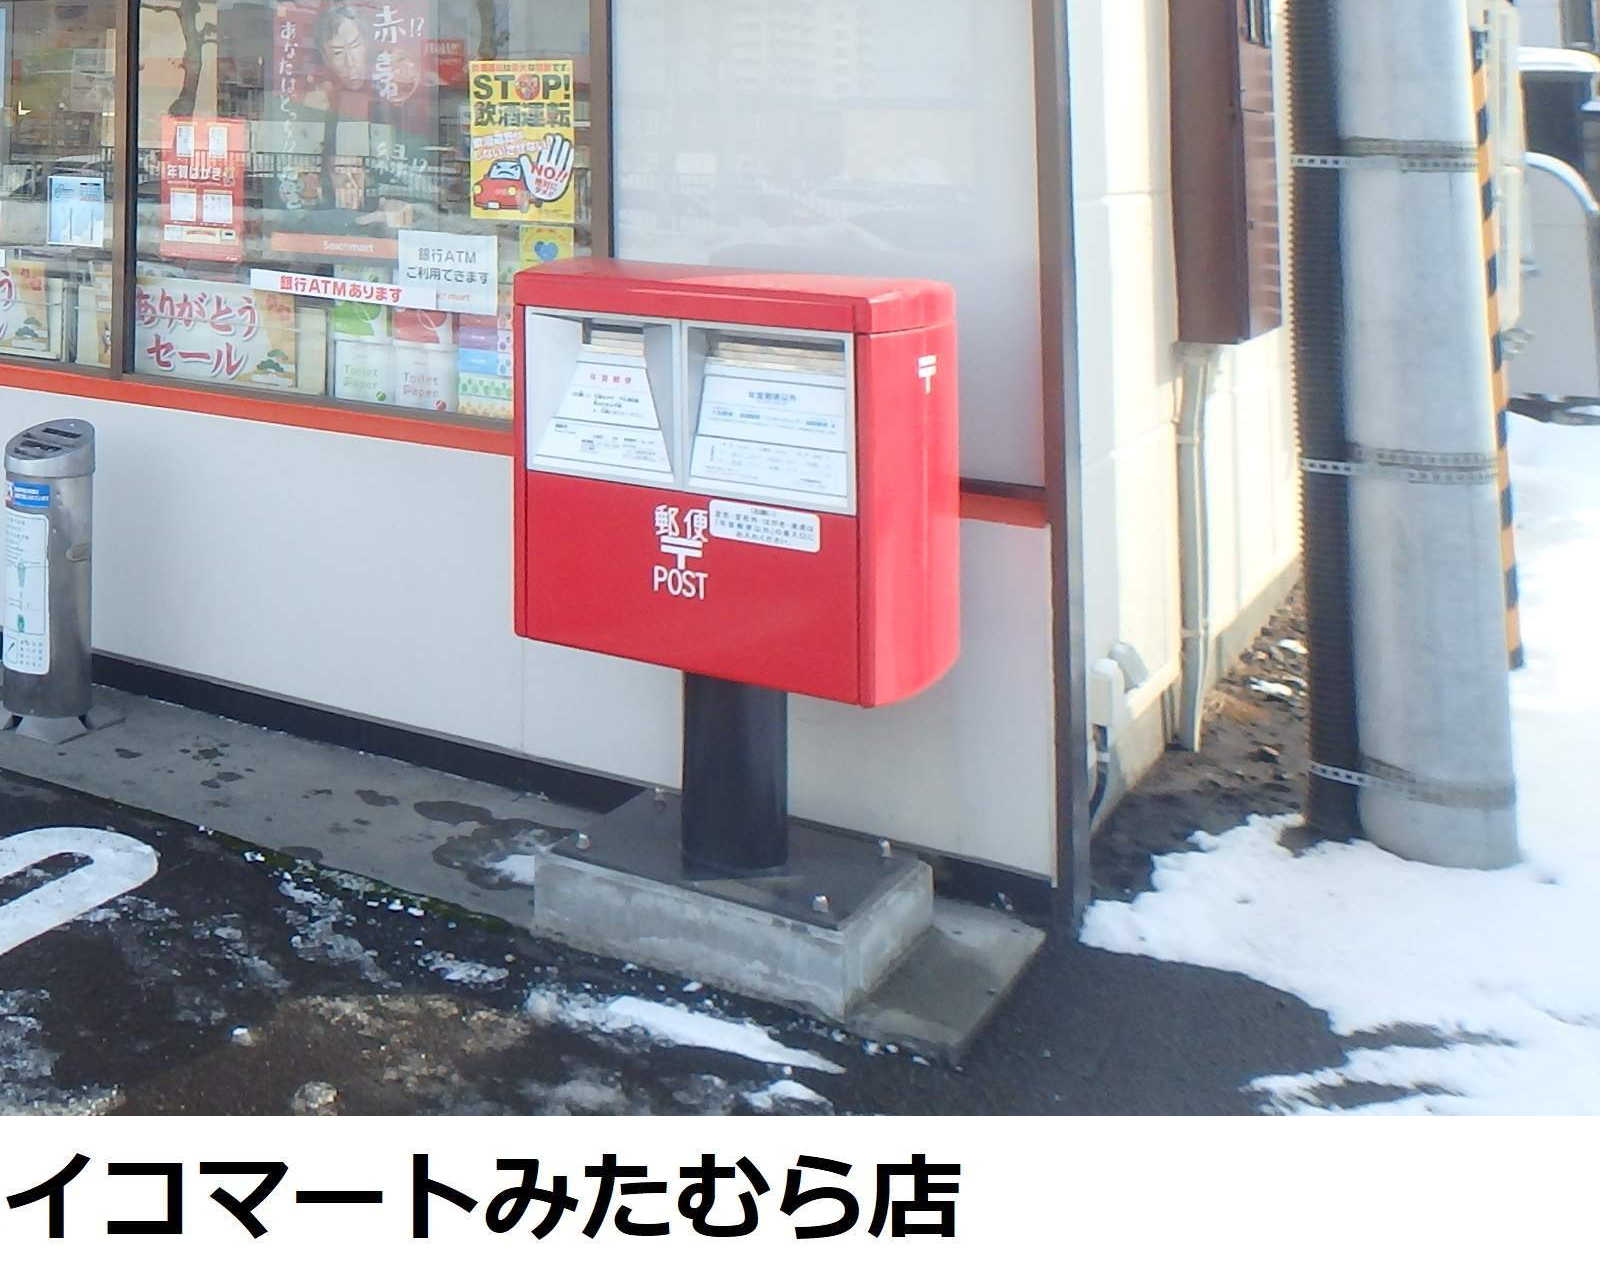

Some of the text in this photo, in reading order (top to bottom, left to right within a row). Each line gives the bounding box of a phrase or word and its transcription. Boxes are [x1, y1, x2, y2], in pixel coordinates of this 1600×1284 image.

[473, 74, 571, 101] STOP!
[474, 101, 571, 128] 飲酒運転
[166, 164, 222, 181] 年賀はがき
[418, 247, 477, 264] 銀行ATM
[279, 274, 404, 304] 銀行ATMあります
[406, 266, 490, 285] ご利用できます
[145, 332, 248, 381] セール
[654, 504, 709, 543] 郵便
[653, 565, 709, 601] POST
